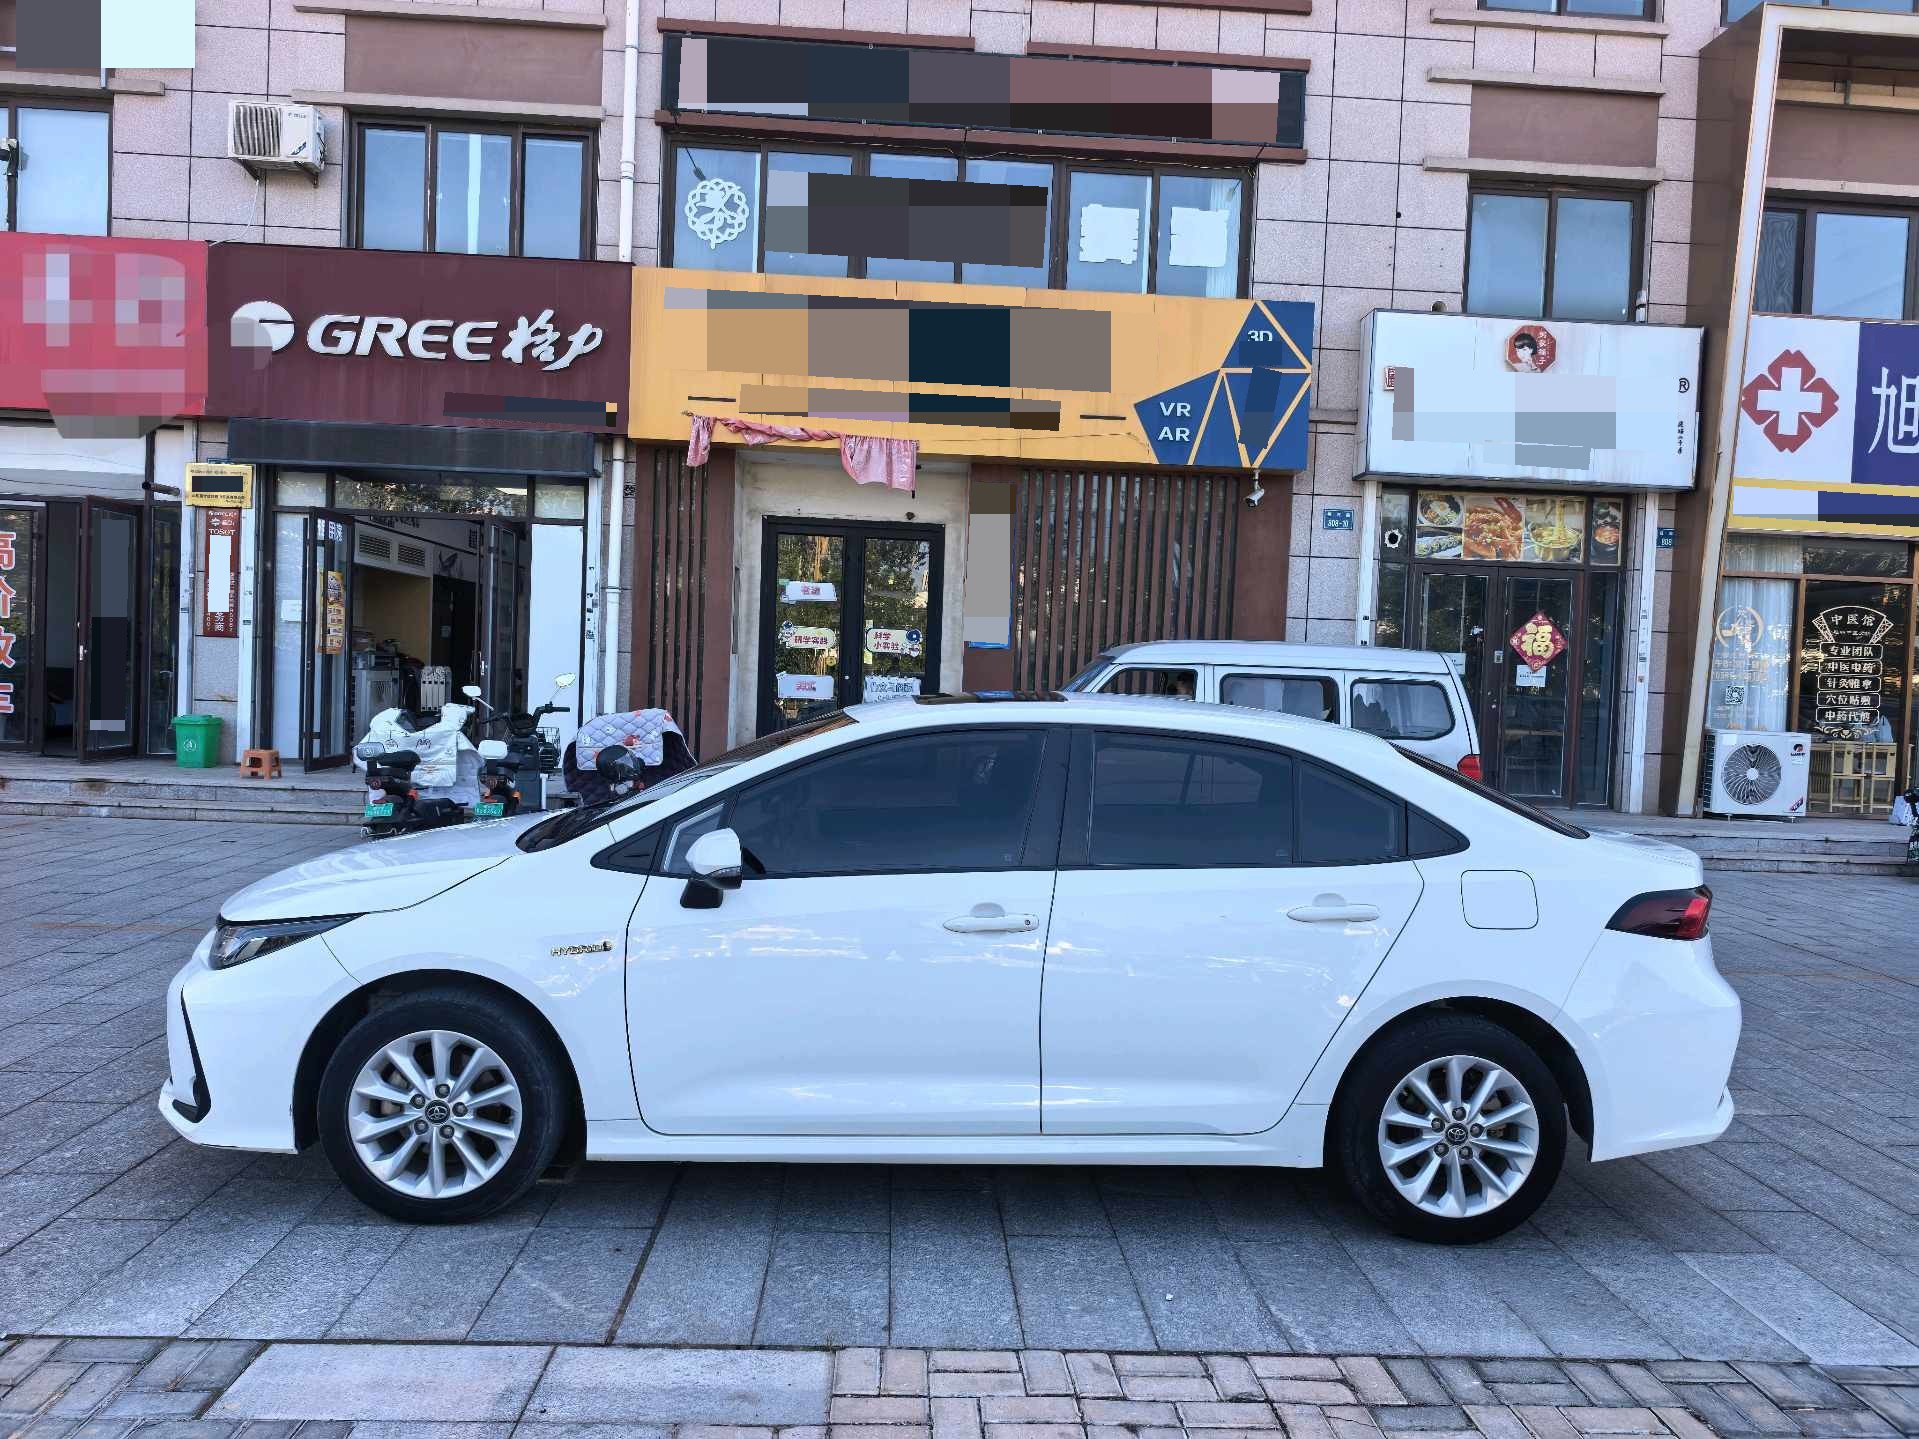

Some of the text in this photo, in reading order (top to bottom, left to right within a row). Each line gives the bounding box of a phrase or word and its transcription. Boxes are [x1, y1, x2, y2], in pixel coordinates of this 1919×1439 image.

[306, 309, 602, 371] GREE 格力
[1247, 329, 1273, 342] 3D
[1159, 401, 1191, 417] VR
[1158, 426, 1191, 442] AR
[1831, 613, 1876, 627] 中医馆
[1521, 622, 1555, 660] 福
[1829, 645, 1874, 657] 专业团队
